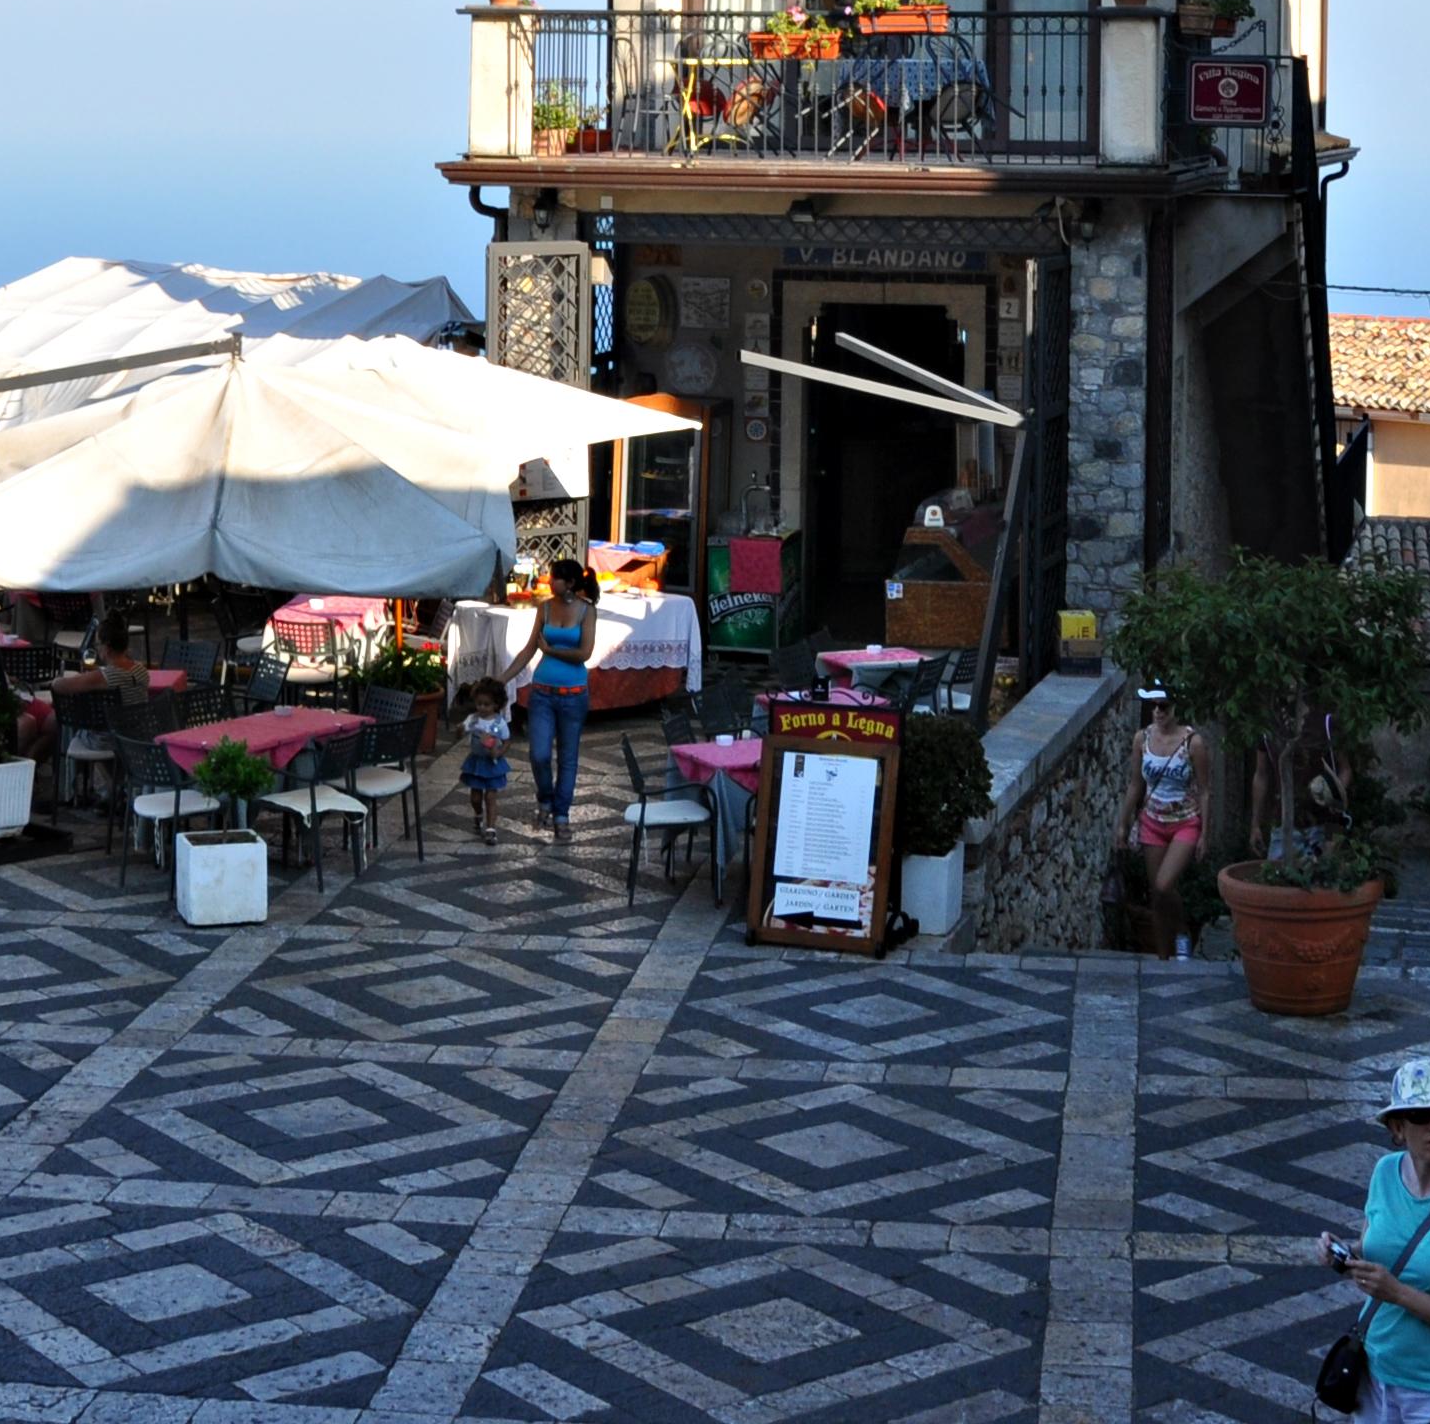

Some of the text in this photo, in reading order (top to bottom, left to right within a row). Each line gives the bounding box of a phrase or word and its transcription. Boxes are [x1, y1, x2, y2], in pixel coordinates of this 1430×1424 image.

[832, 248, 967, 268] BLANDANO
[1005, 302, 1012, 314] 2
[779, 711, 895, 740] Forno a Legna
[779, 886, 818, 897] GIARDINO
[824, 890, 858, 901] GARDEN
[785, 899, 813, 909] JARDIN
[823, 903, 855, 914] GARTEN
